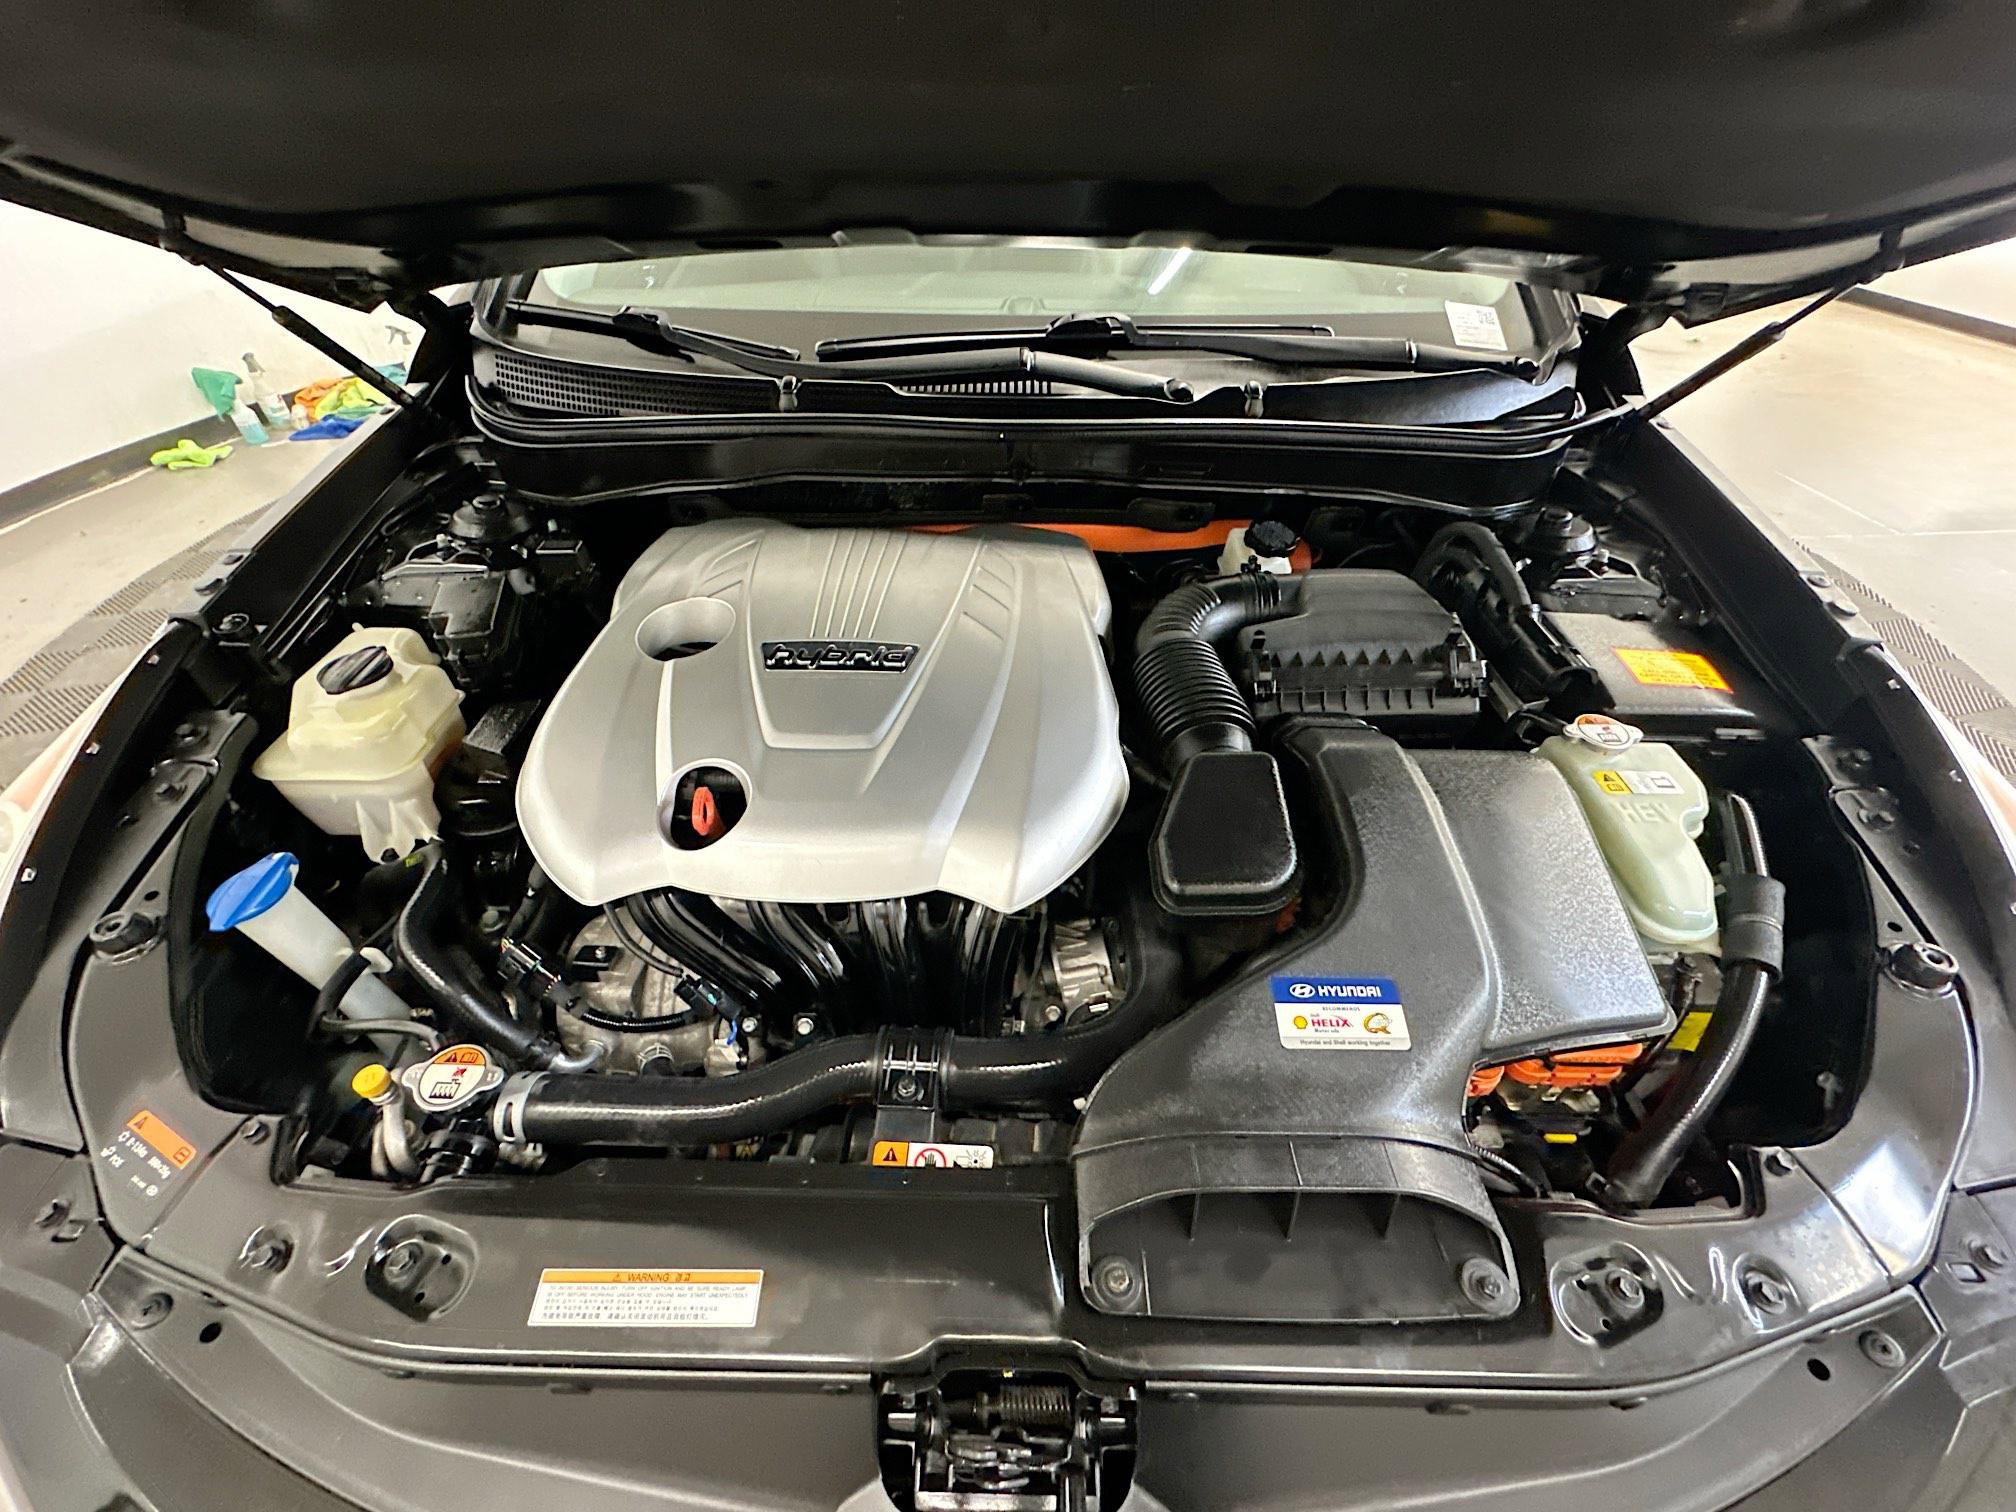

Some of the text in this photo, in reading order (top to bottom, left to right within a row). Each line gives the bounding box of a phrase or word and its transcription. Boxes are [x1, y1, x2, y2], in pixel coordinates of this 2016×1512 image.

[766, 643, 913, 669] hybrid
[1317, 985, 1382, 997] HYUNDAI
[1311, 1018, 1351, 1028] HELIX
[627, 1272, 670, 1282] WARNING
